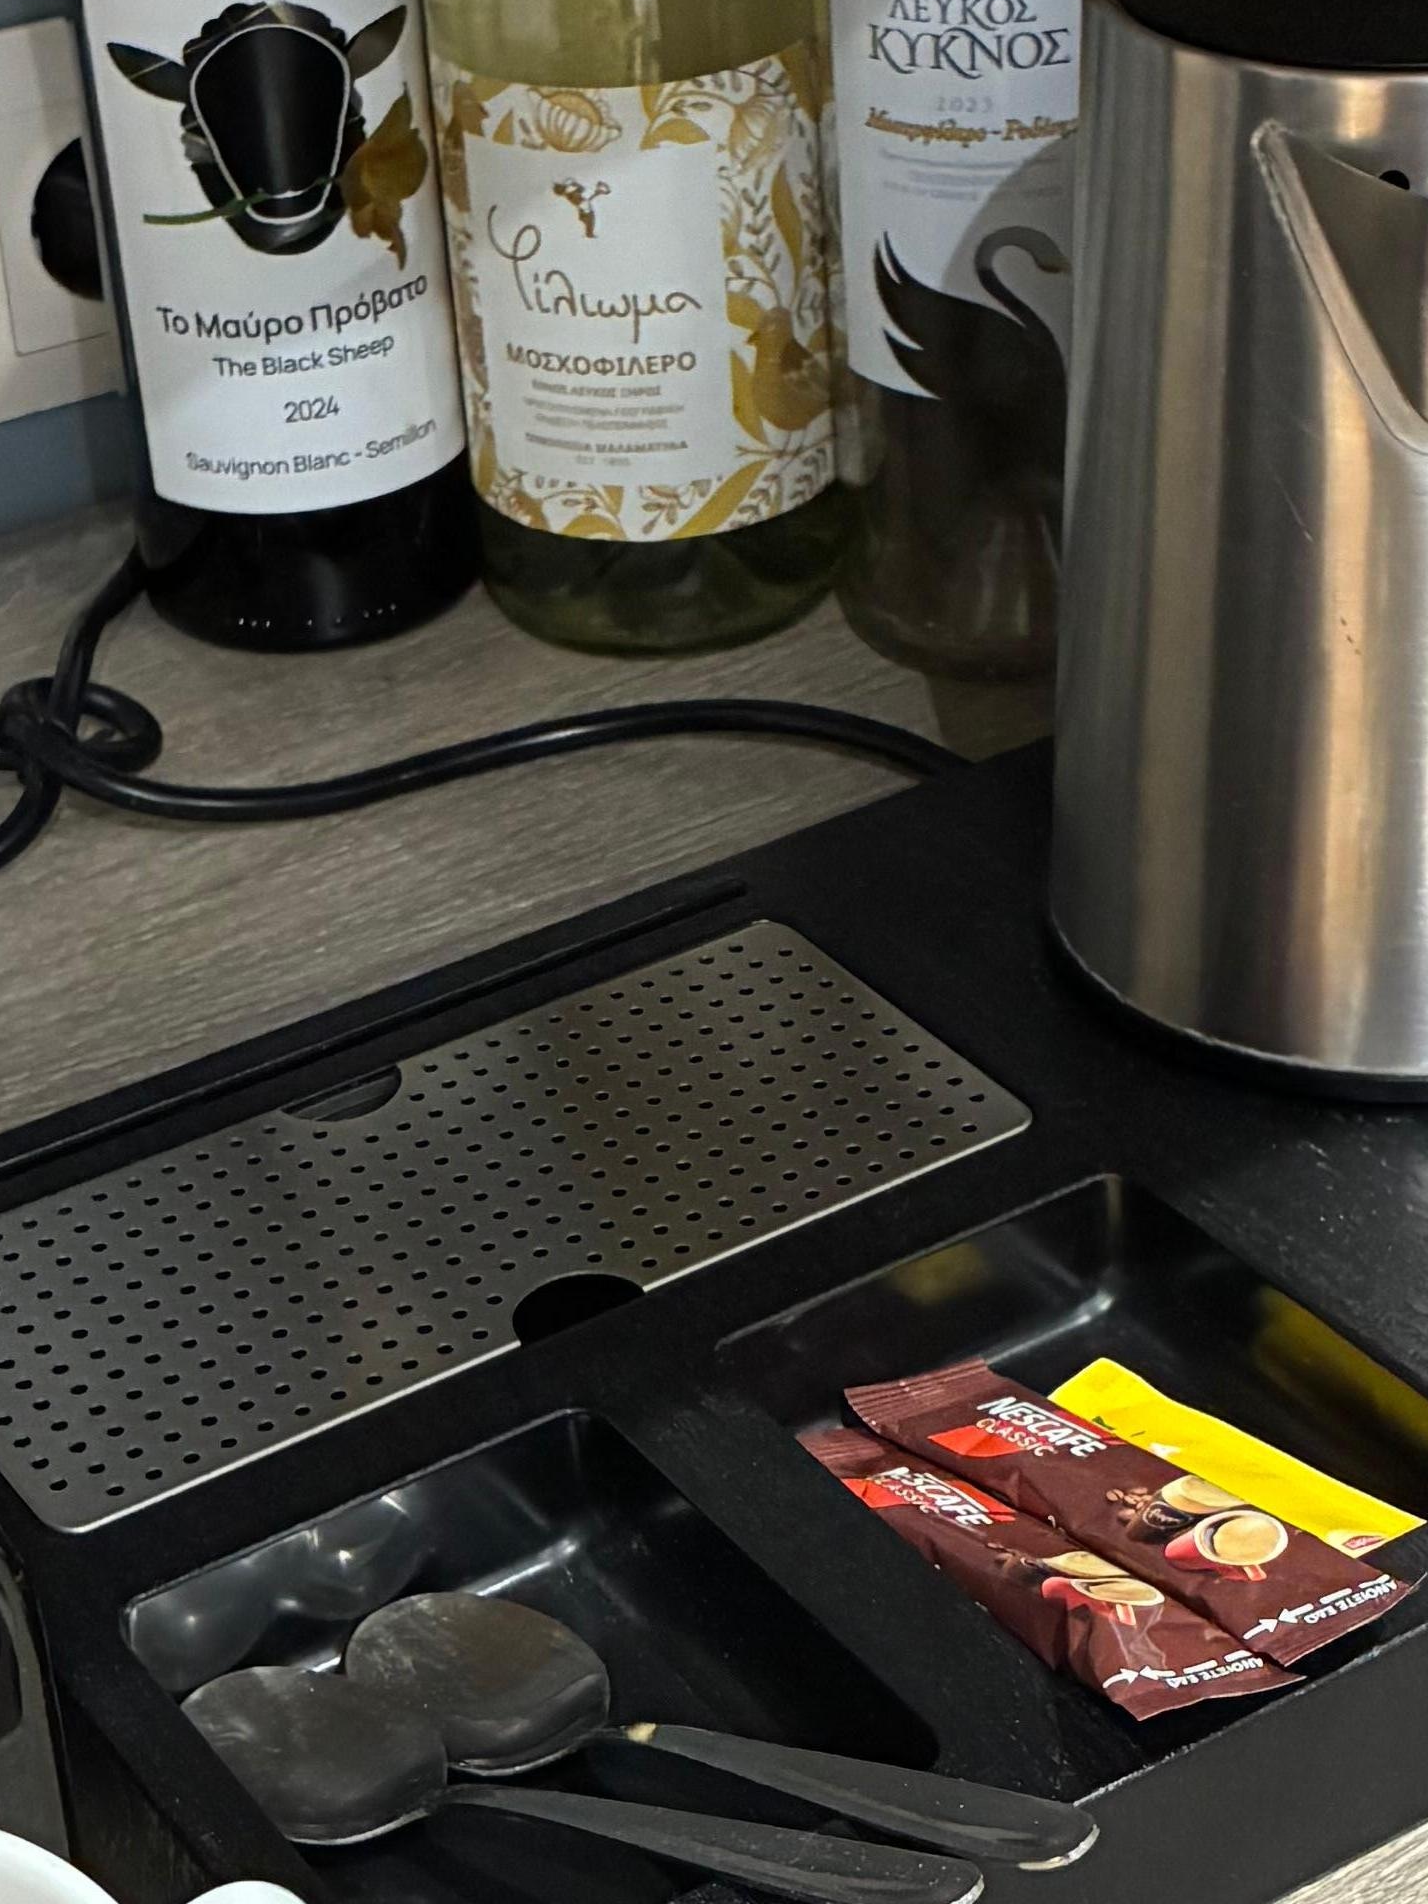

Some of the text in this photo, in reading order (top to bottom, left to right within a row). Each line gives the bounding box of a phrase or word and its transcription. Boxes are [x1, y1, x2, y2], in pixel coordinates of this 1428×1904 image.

[196, 309, 303, 345] Μαύρο
[310, 274, 428, 335] Πρόβατο
[213, 334, 395, 377] The Black Sheep
[284, 395, 340, 424] 2024
[185, 451, 290, 480] Sauvignon
[293, 449, 352, 474] Blanc
[975, 1417, 1057, 1457] CLASSIC
